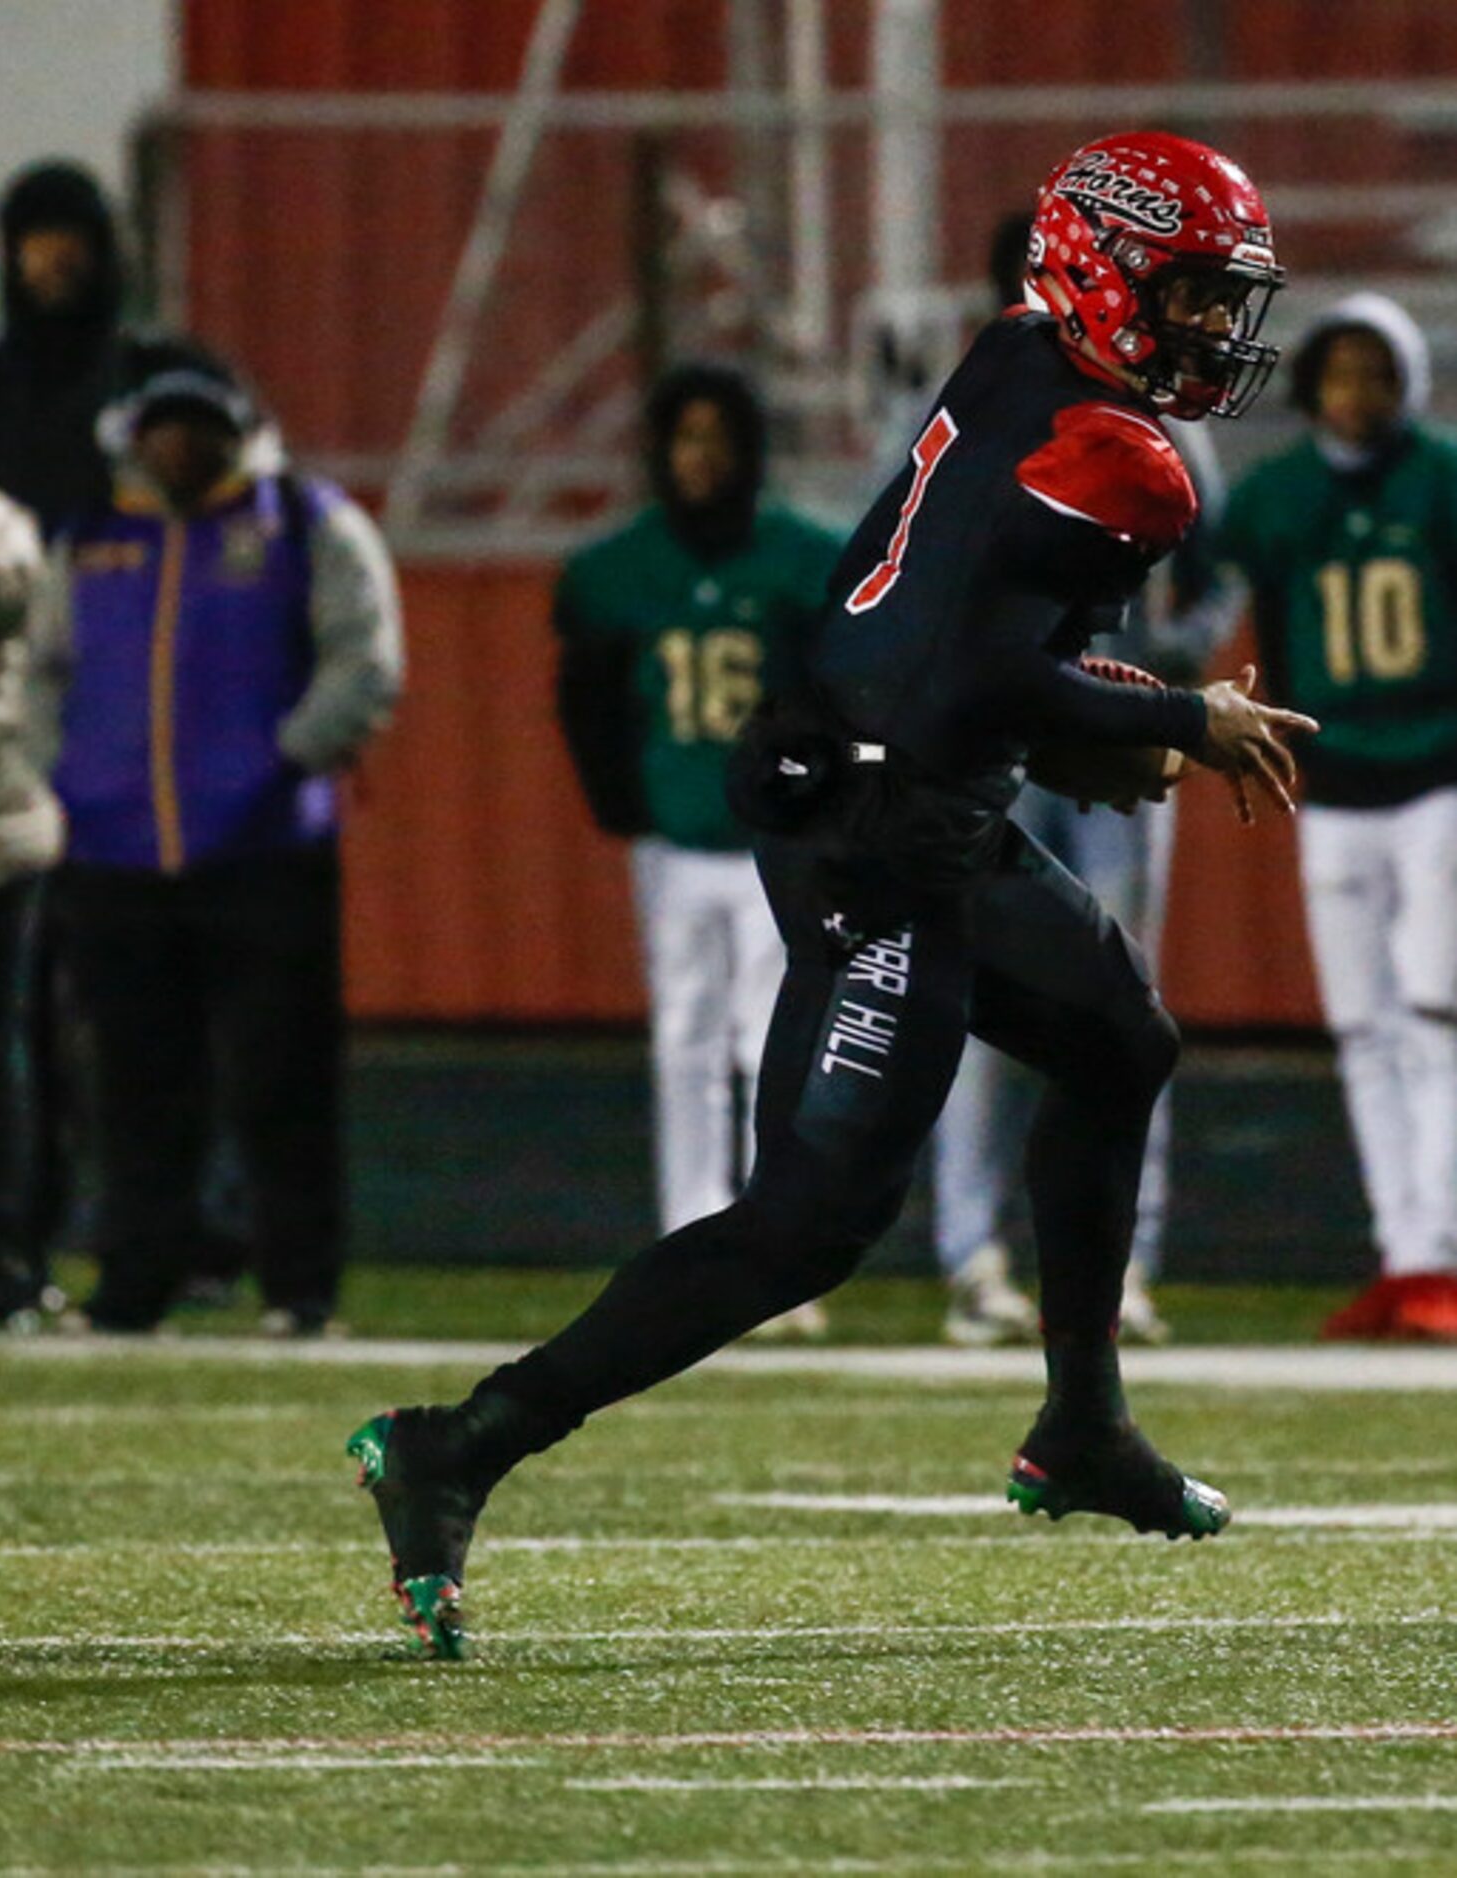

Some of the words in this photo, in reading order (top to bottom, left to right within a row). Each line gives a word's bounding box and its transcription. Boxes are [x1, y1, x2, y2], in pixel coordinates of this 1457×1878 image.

[1317, 558, 1427, 686] 10
[657, 627, 764, 745] 16
[821, 998, 898, 1080] HILL
